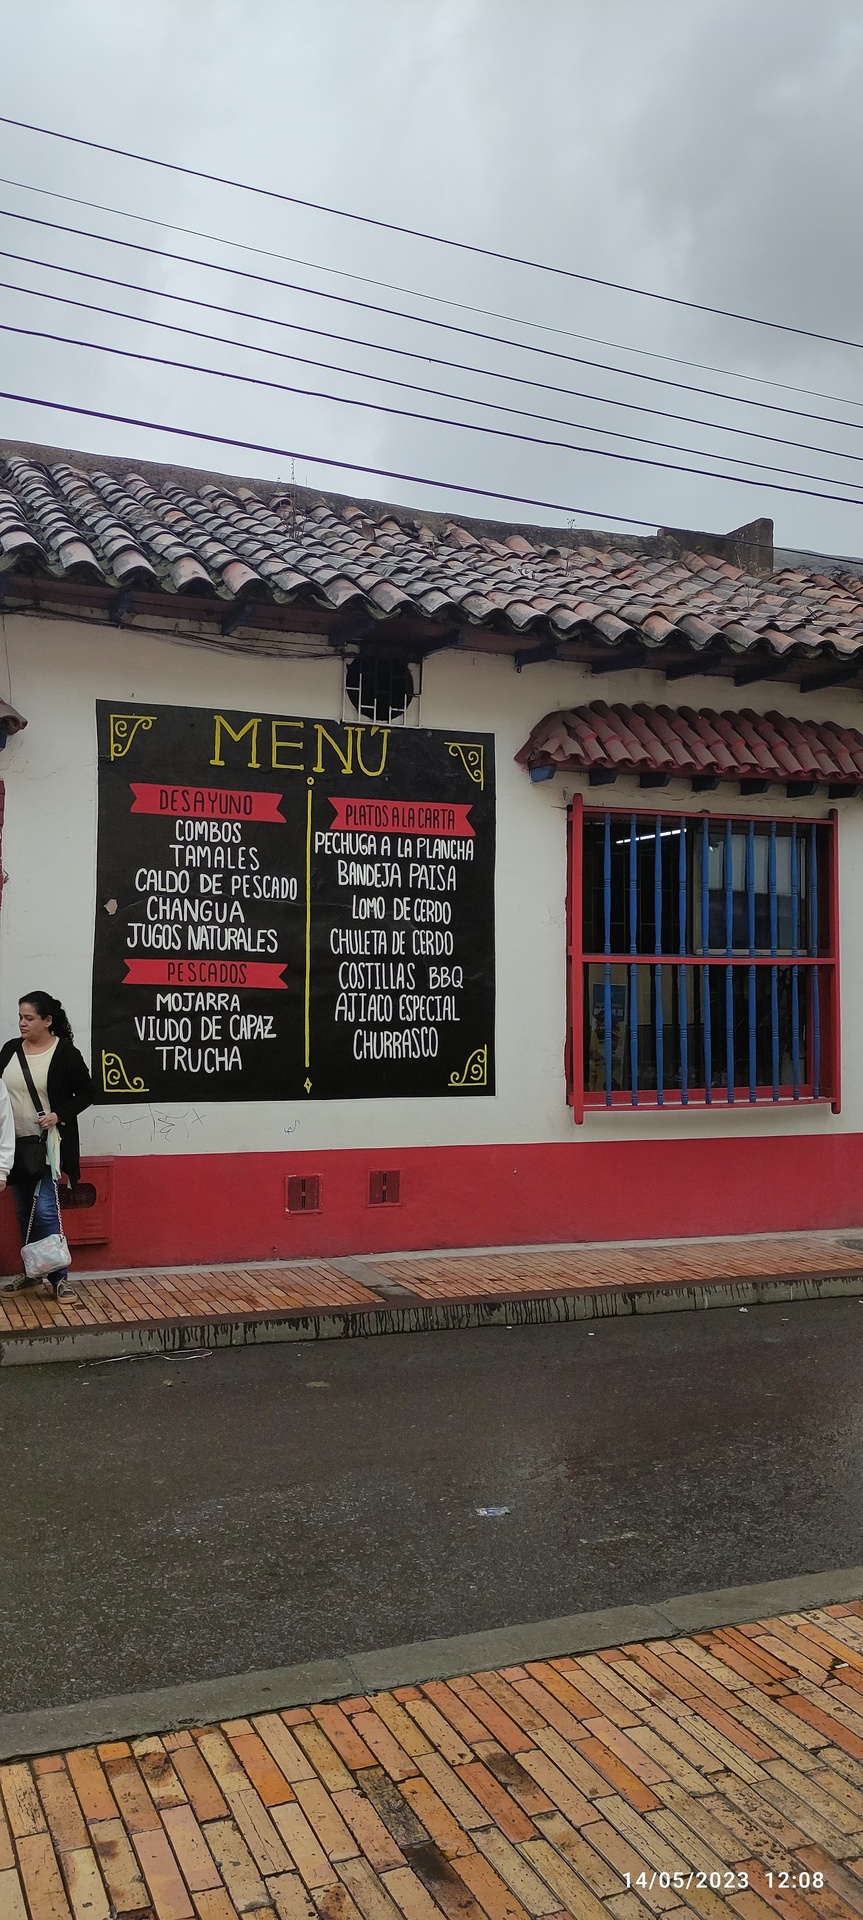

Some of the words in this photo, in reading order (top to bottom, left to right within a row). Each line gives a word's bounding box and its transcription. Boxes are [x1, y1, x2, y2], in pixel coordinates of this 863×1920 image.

[209, 715, 391, 777] MENÚ
[159, 789, 252, 815] DESAYUNO
[345, 804, 388, 827] PLATOS
[392, 807, 399, 827] A
[402, 808, 414, 828] LA
[418, 808, 455, 830] CARTA
[176, 820, 241, 843] COMBOS
[169, 845, 260, 870] TAMALES
[315, 832, 376, 855] PECHUGA
[381, 836, 390, 856] A
[398, 838, 412, 858] LA
[417, 838, 474, 860] PLANCHA
[135, 868, 190, 894] CALDO
[200, 874, 223, 895] DE
[231, 875, 298, 900] PESCADO
[338, 860, 401, 887] BANDEJA
[409, 863, 456, 891] PAISA
[147, 896, 244, 923] CHANGUA
[352, 895, 385, 919] LOMO
[394, 897, 411, 921] DE
[414, 898, 451, 924] CERDO
[127, 923, 182, 950] JUGOS
[188, 925, 278, 953] NATURALES
[330, 928, 387, 955] CHULETA
[392, 931, 405, 955] DE
[412, 930, 454, 955] CERDO
[167, 962, 247, 984] PESCADOS
[339, 962, 415, 990] COSTILLAS
[429, 966, 463, 989] BBQ
[157, 992, 240, 1011] MOJARRA
[335, 993, 392, 1022] AJIACO
[400, 995, 460, 1022] ESPECIAL
[134, 1016, 191, 1042] VIUDO
[201, 1016, 222, 1040] DE
[230, 1015, 277, 1040] CAPAZ
[353, 1027, 438, 1060] CHURRASCO
[155, 1046, 242, 1073] TRUCHA
